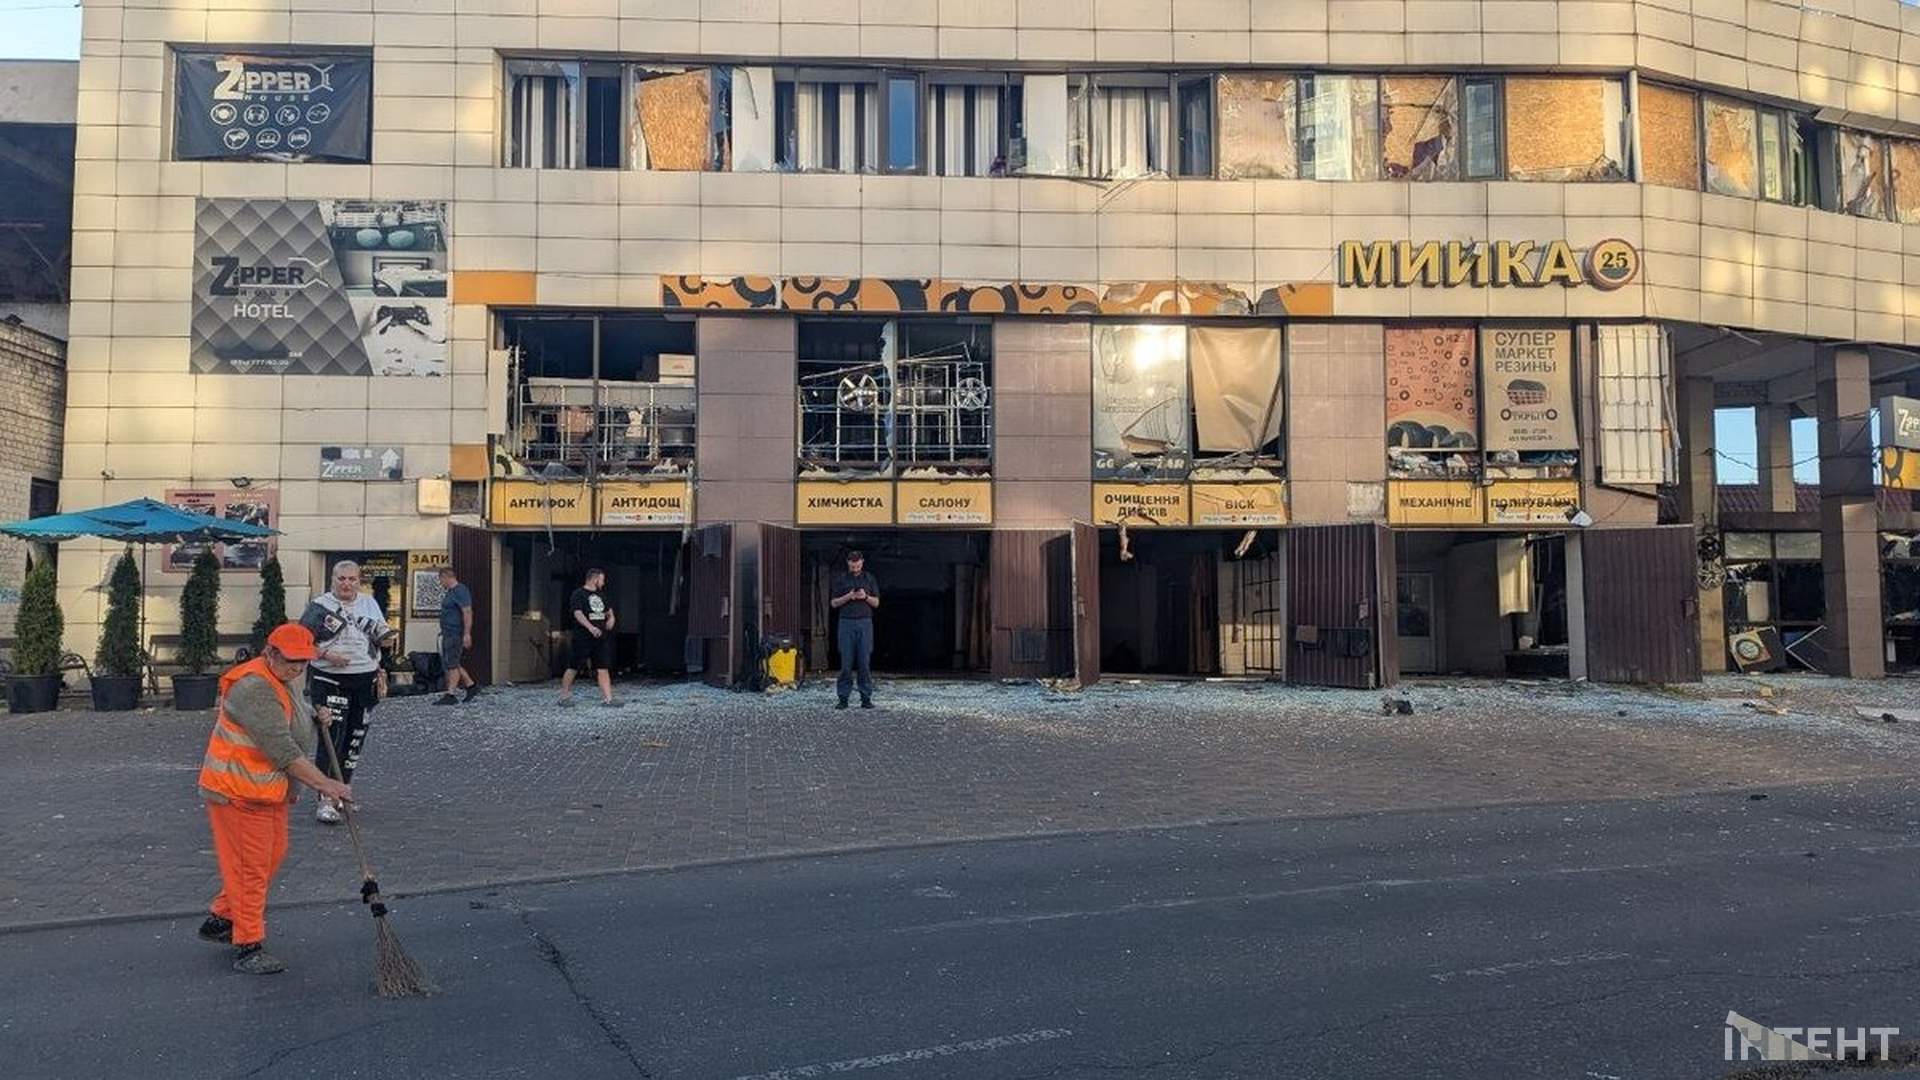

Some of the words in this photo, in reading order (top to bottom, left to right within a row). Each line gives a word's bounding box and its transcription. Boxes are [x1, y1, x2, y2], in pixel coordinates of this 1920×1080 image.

[1601, 251, 1628, 269] 25
[233, 303, 295, 319] HOTEL
[1495, 331, 1556, 346] СУПЕР
[1495, 347, 1555, 360] МАРКЕТ
[1495, 361, 1557, 373] РЕЗИНЫ
[611, 497, 681, 509] АНТИДОЩ
[808, 497, 884, 508] ХІМЧИСТКА
[919, 497, 971, 508] САЛОНУ
[1104, 494, 1180, 506] ОЧИЩЕННЯ
[1225, 500, 1255, 510] ВІСК
[1400, 497, 1472, 508] МЕХАНІЧНЕ
[1117, 507, 1168, 518] ДИСКІВ
